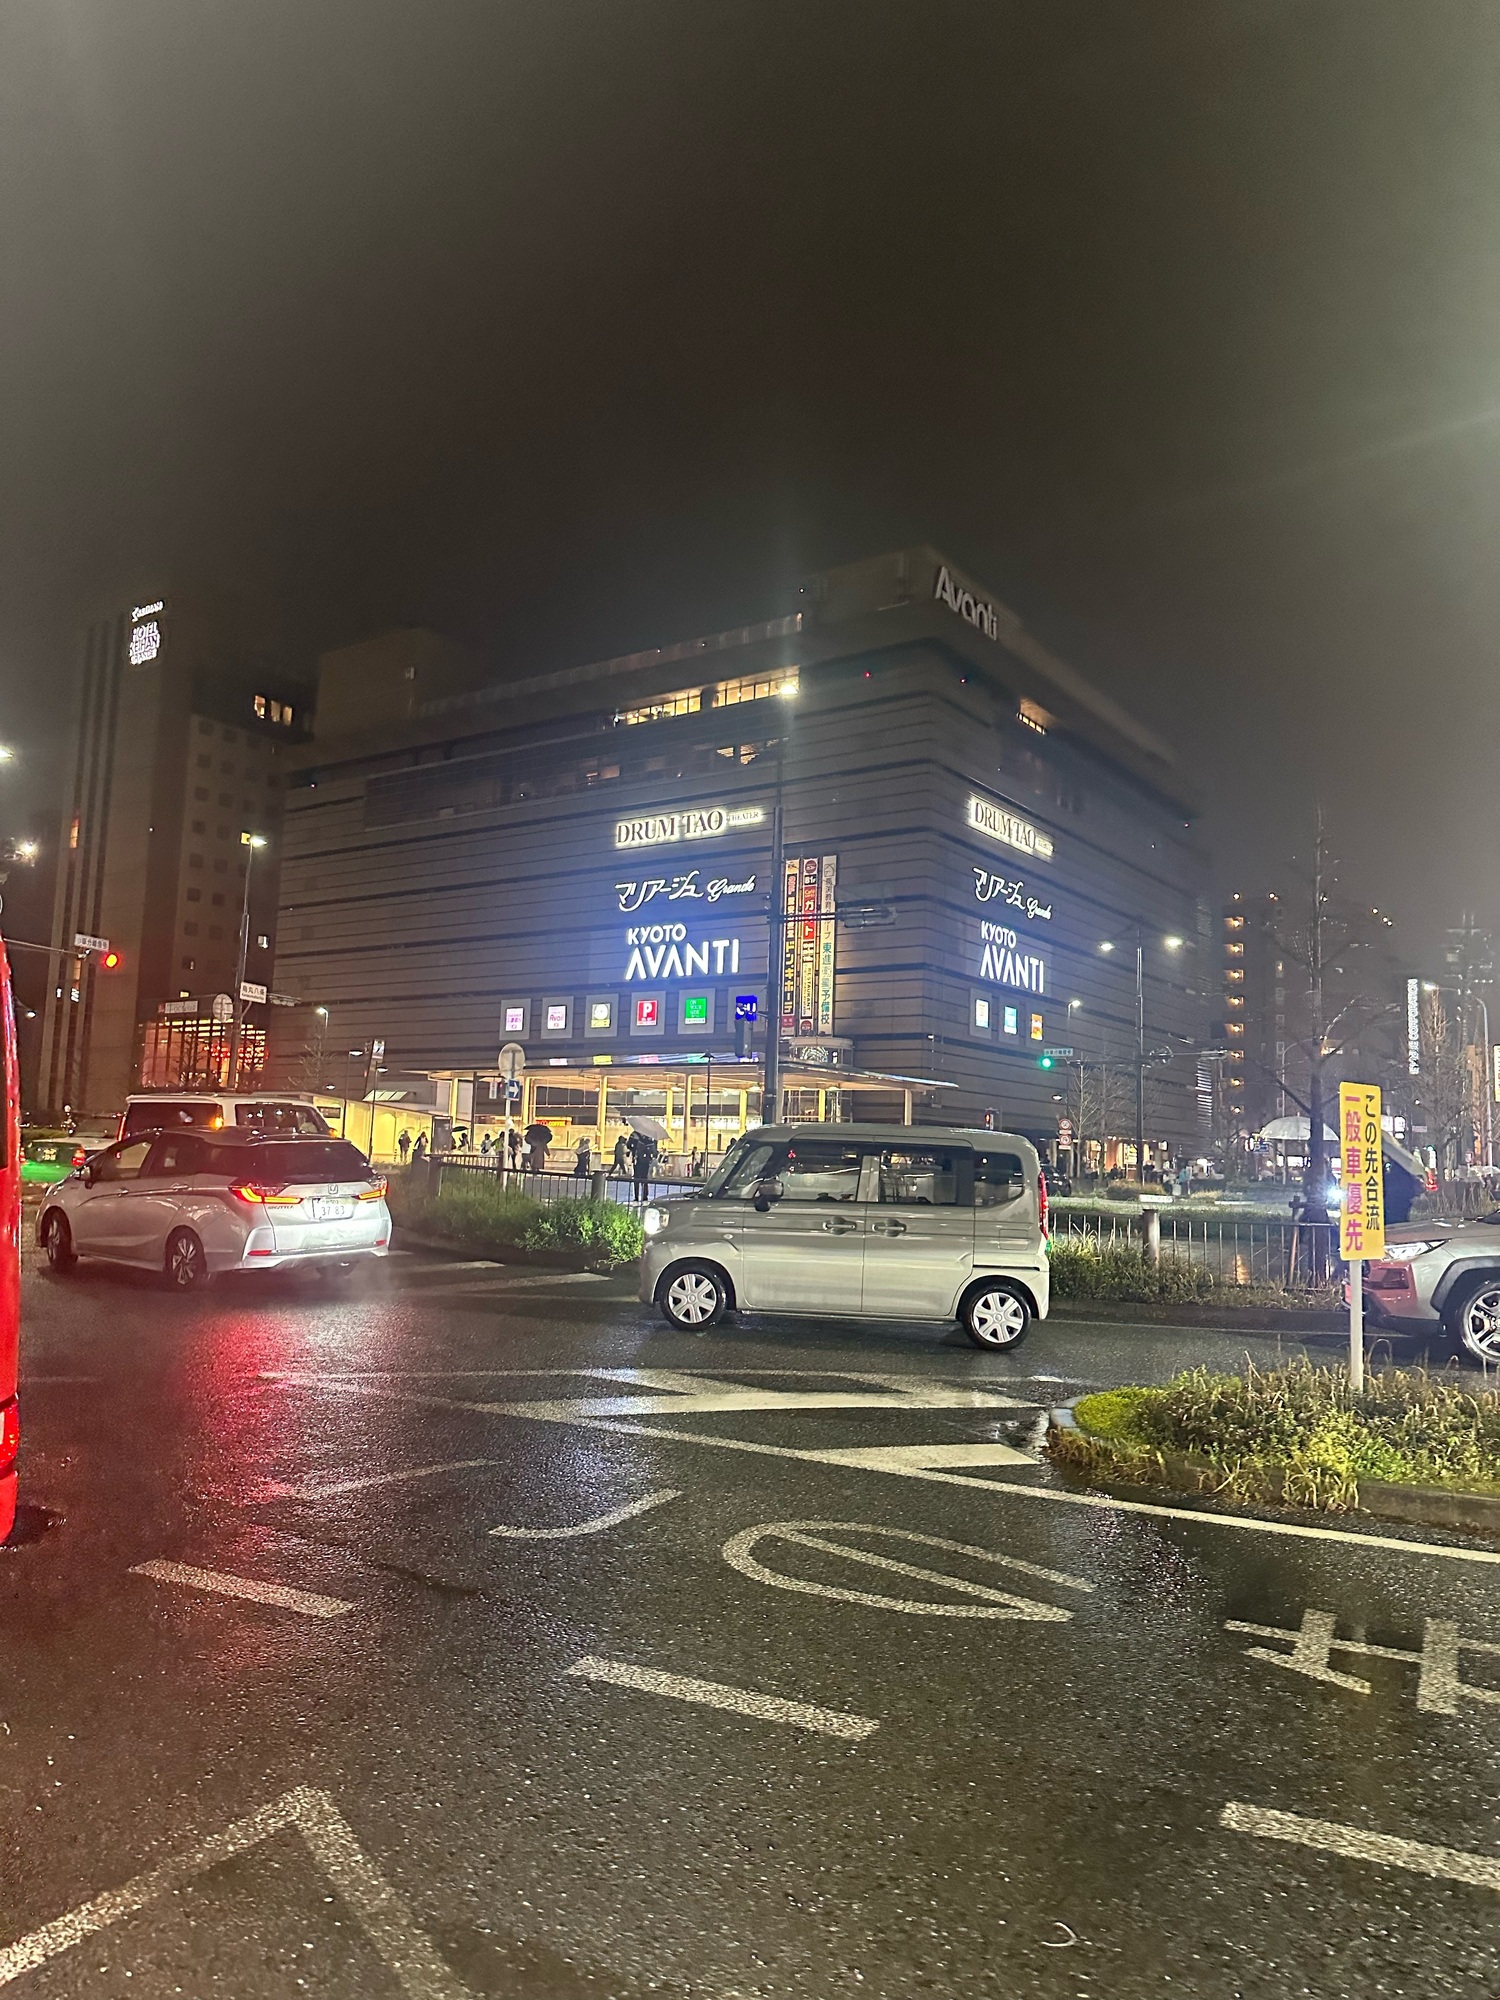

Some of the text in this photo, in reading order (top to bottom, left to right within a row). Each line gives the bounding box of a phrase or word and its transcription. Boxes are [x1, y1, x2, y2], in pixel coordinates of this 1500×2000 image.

[934, 566, 998, 641] Avanti
[617, 810, 759, 844] DRUM TAO THEATER
[974, 801, 1011, 840] DRUM
[1013, 820, 1036, 850] TAO
[707, 874, 756, 903] Grande
[627, 923, 687, 946] KYOTO
[980, 920, 1017, 949] KYOTO
[624, 938, 740, 981] AVANTI
[979, 943, 1045, 994] AVANTI
[1344, 1096, 1363, 1252] 一般車優先
[1365, 1094, 1380, 1231] この先合流
